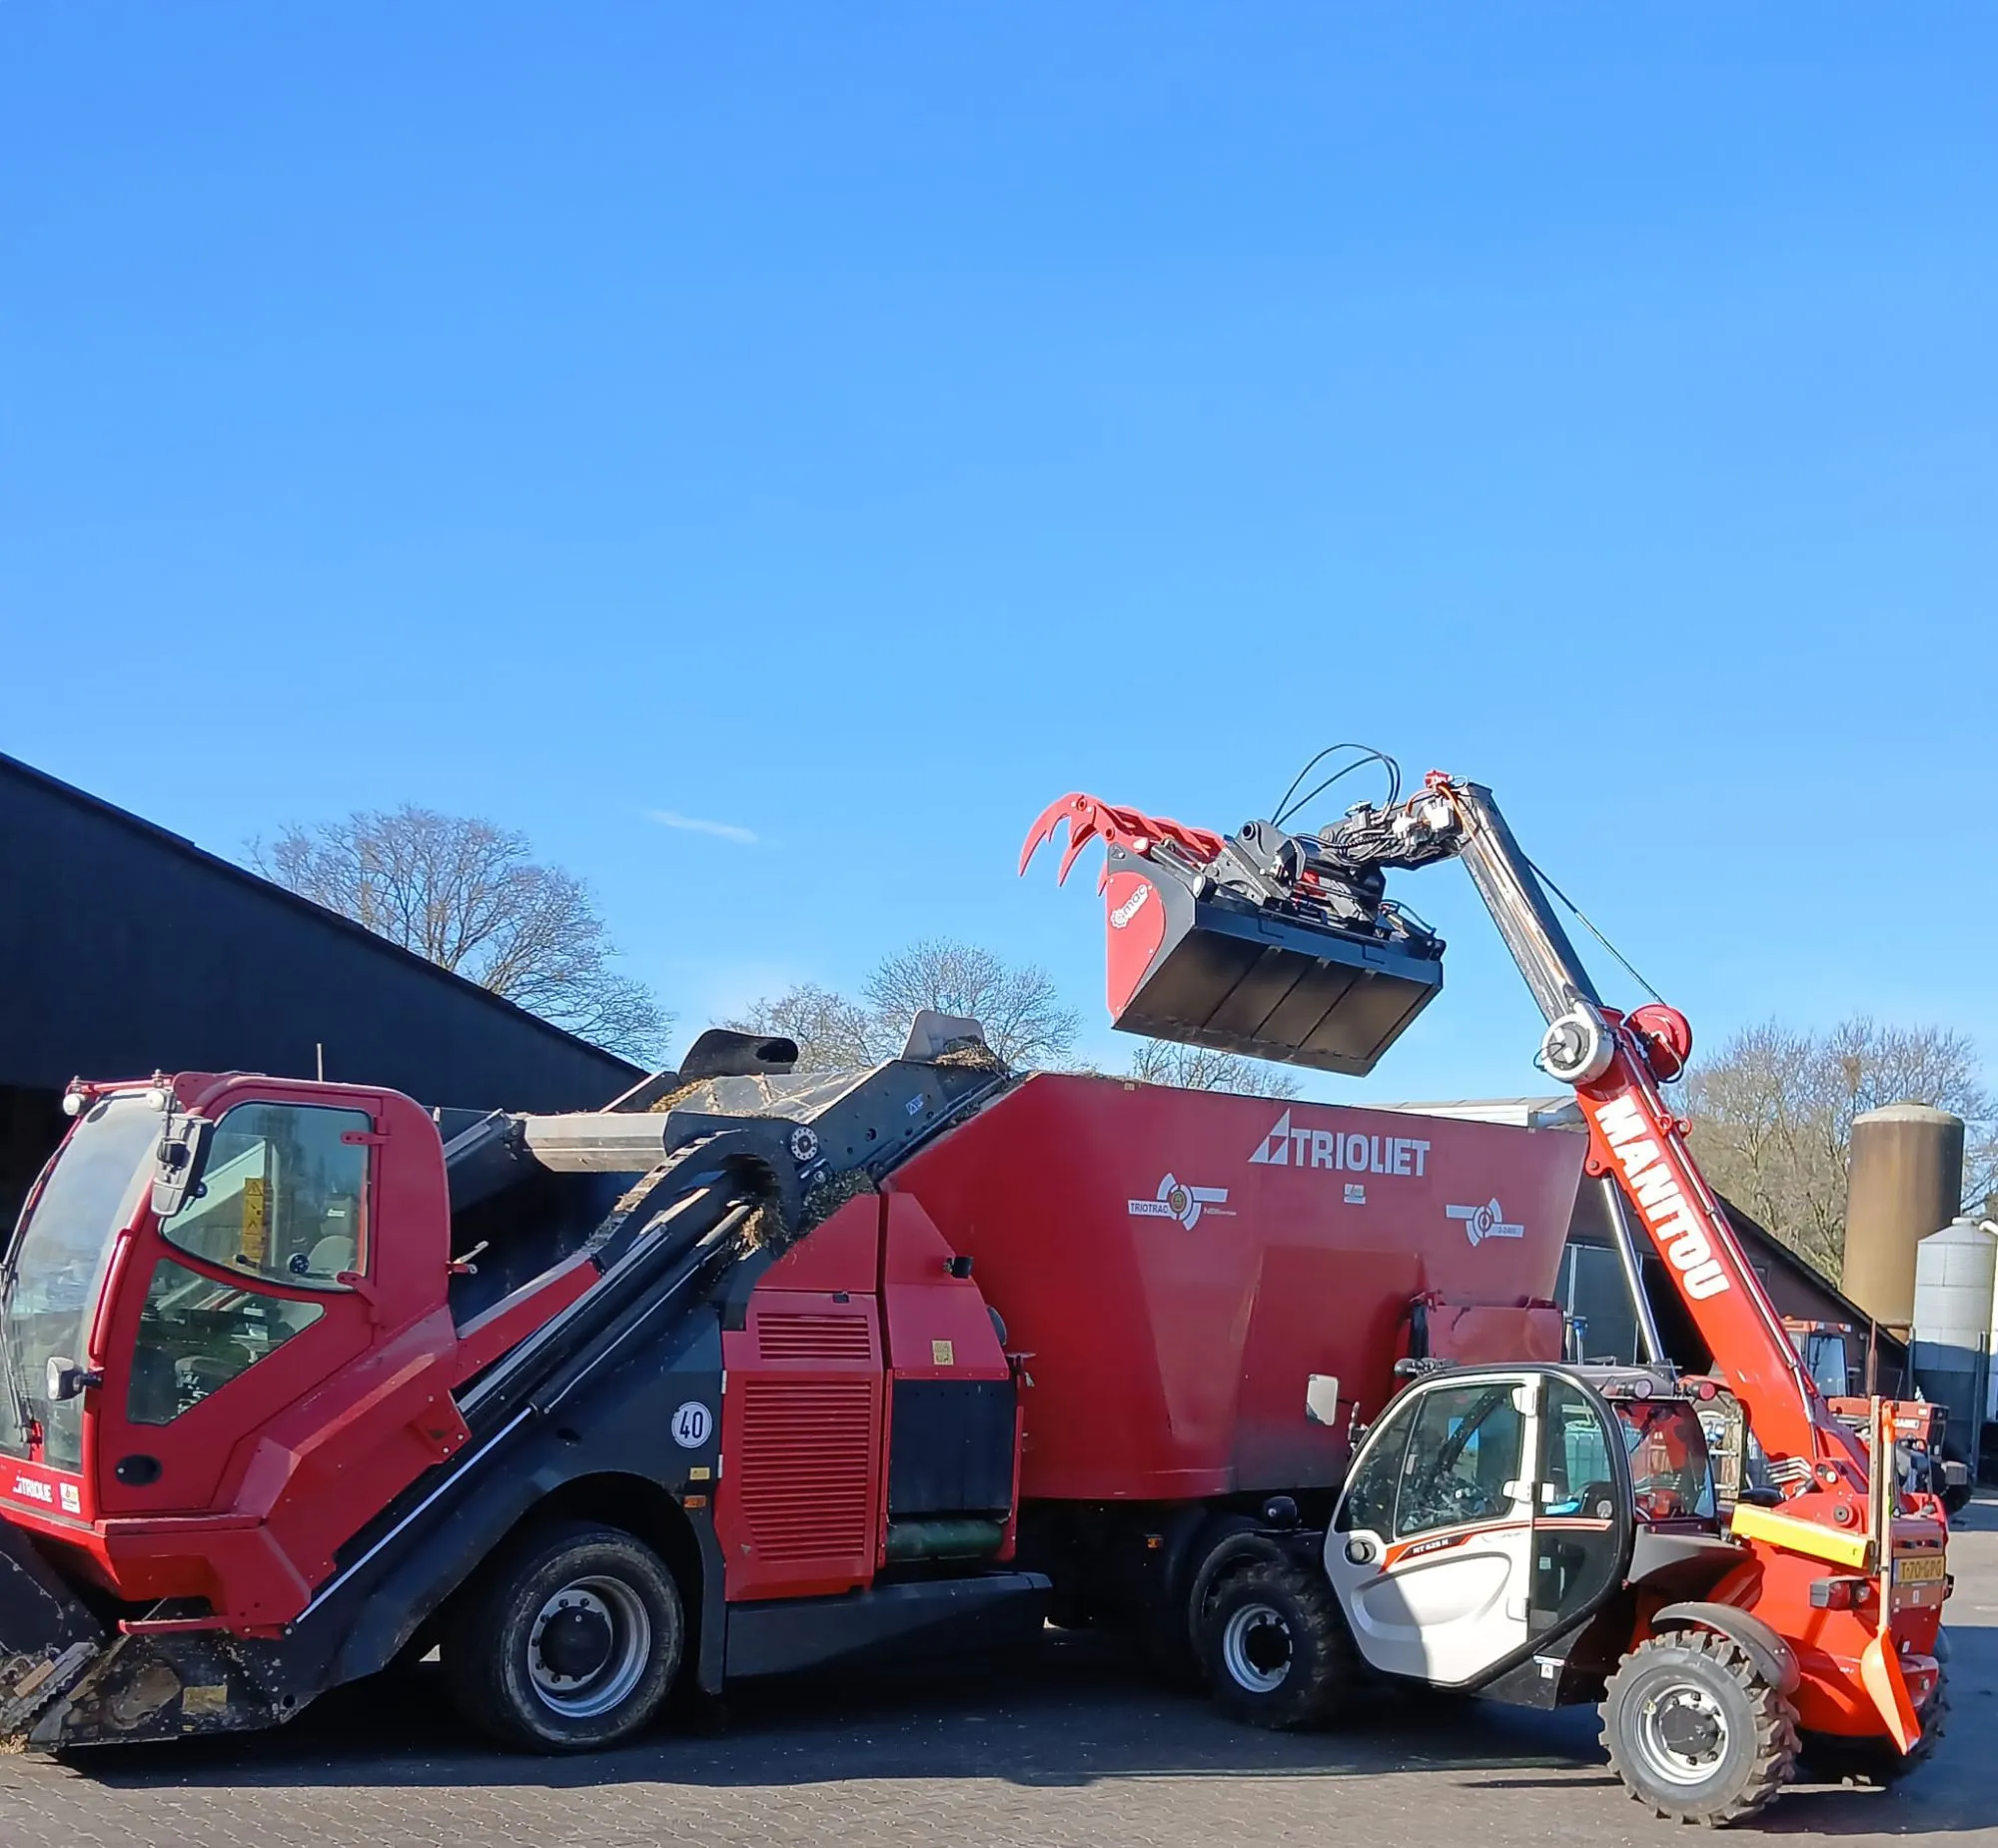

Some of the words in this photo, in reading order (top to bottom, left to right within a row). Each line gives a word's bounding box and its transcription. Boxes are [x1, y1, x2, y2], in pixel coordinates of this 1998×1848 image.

[1290, 1127, 1432, 1178] TRIOLIET
[1594, 1095, 1730, 1301] MANITOU
[679, 1410, 704, 1439] 40
